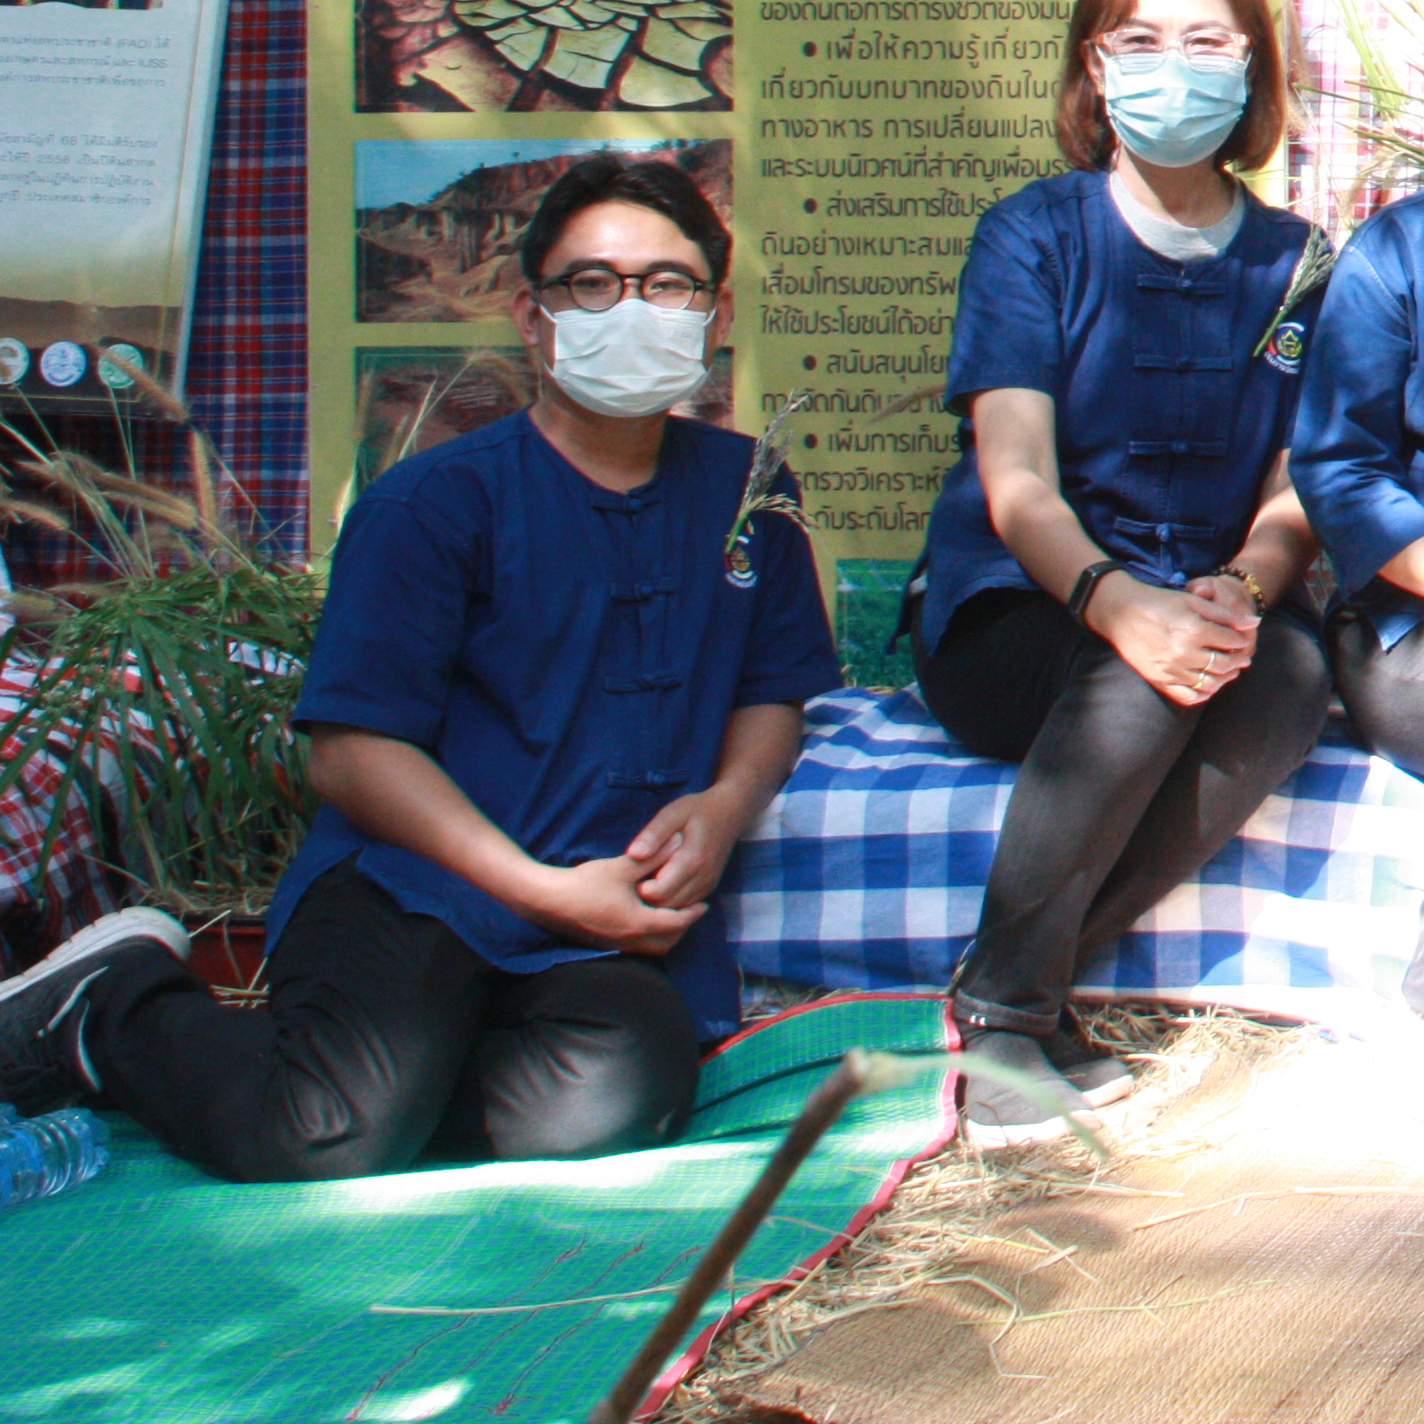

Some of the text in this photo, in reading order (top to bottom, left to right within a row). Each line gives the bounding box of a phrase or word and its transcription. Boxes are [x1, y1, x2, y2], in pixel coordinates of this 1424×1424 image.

[762, 116, 874, 139] ทางอาหาร
[762, 145, 1066, 182] และระบบนิเวศน์ที่สำคัญเพื่อบร
